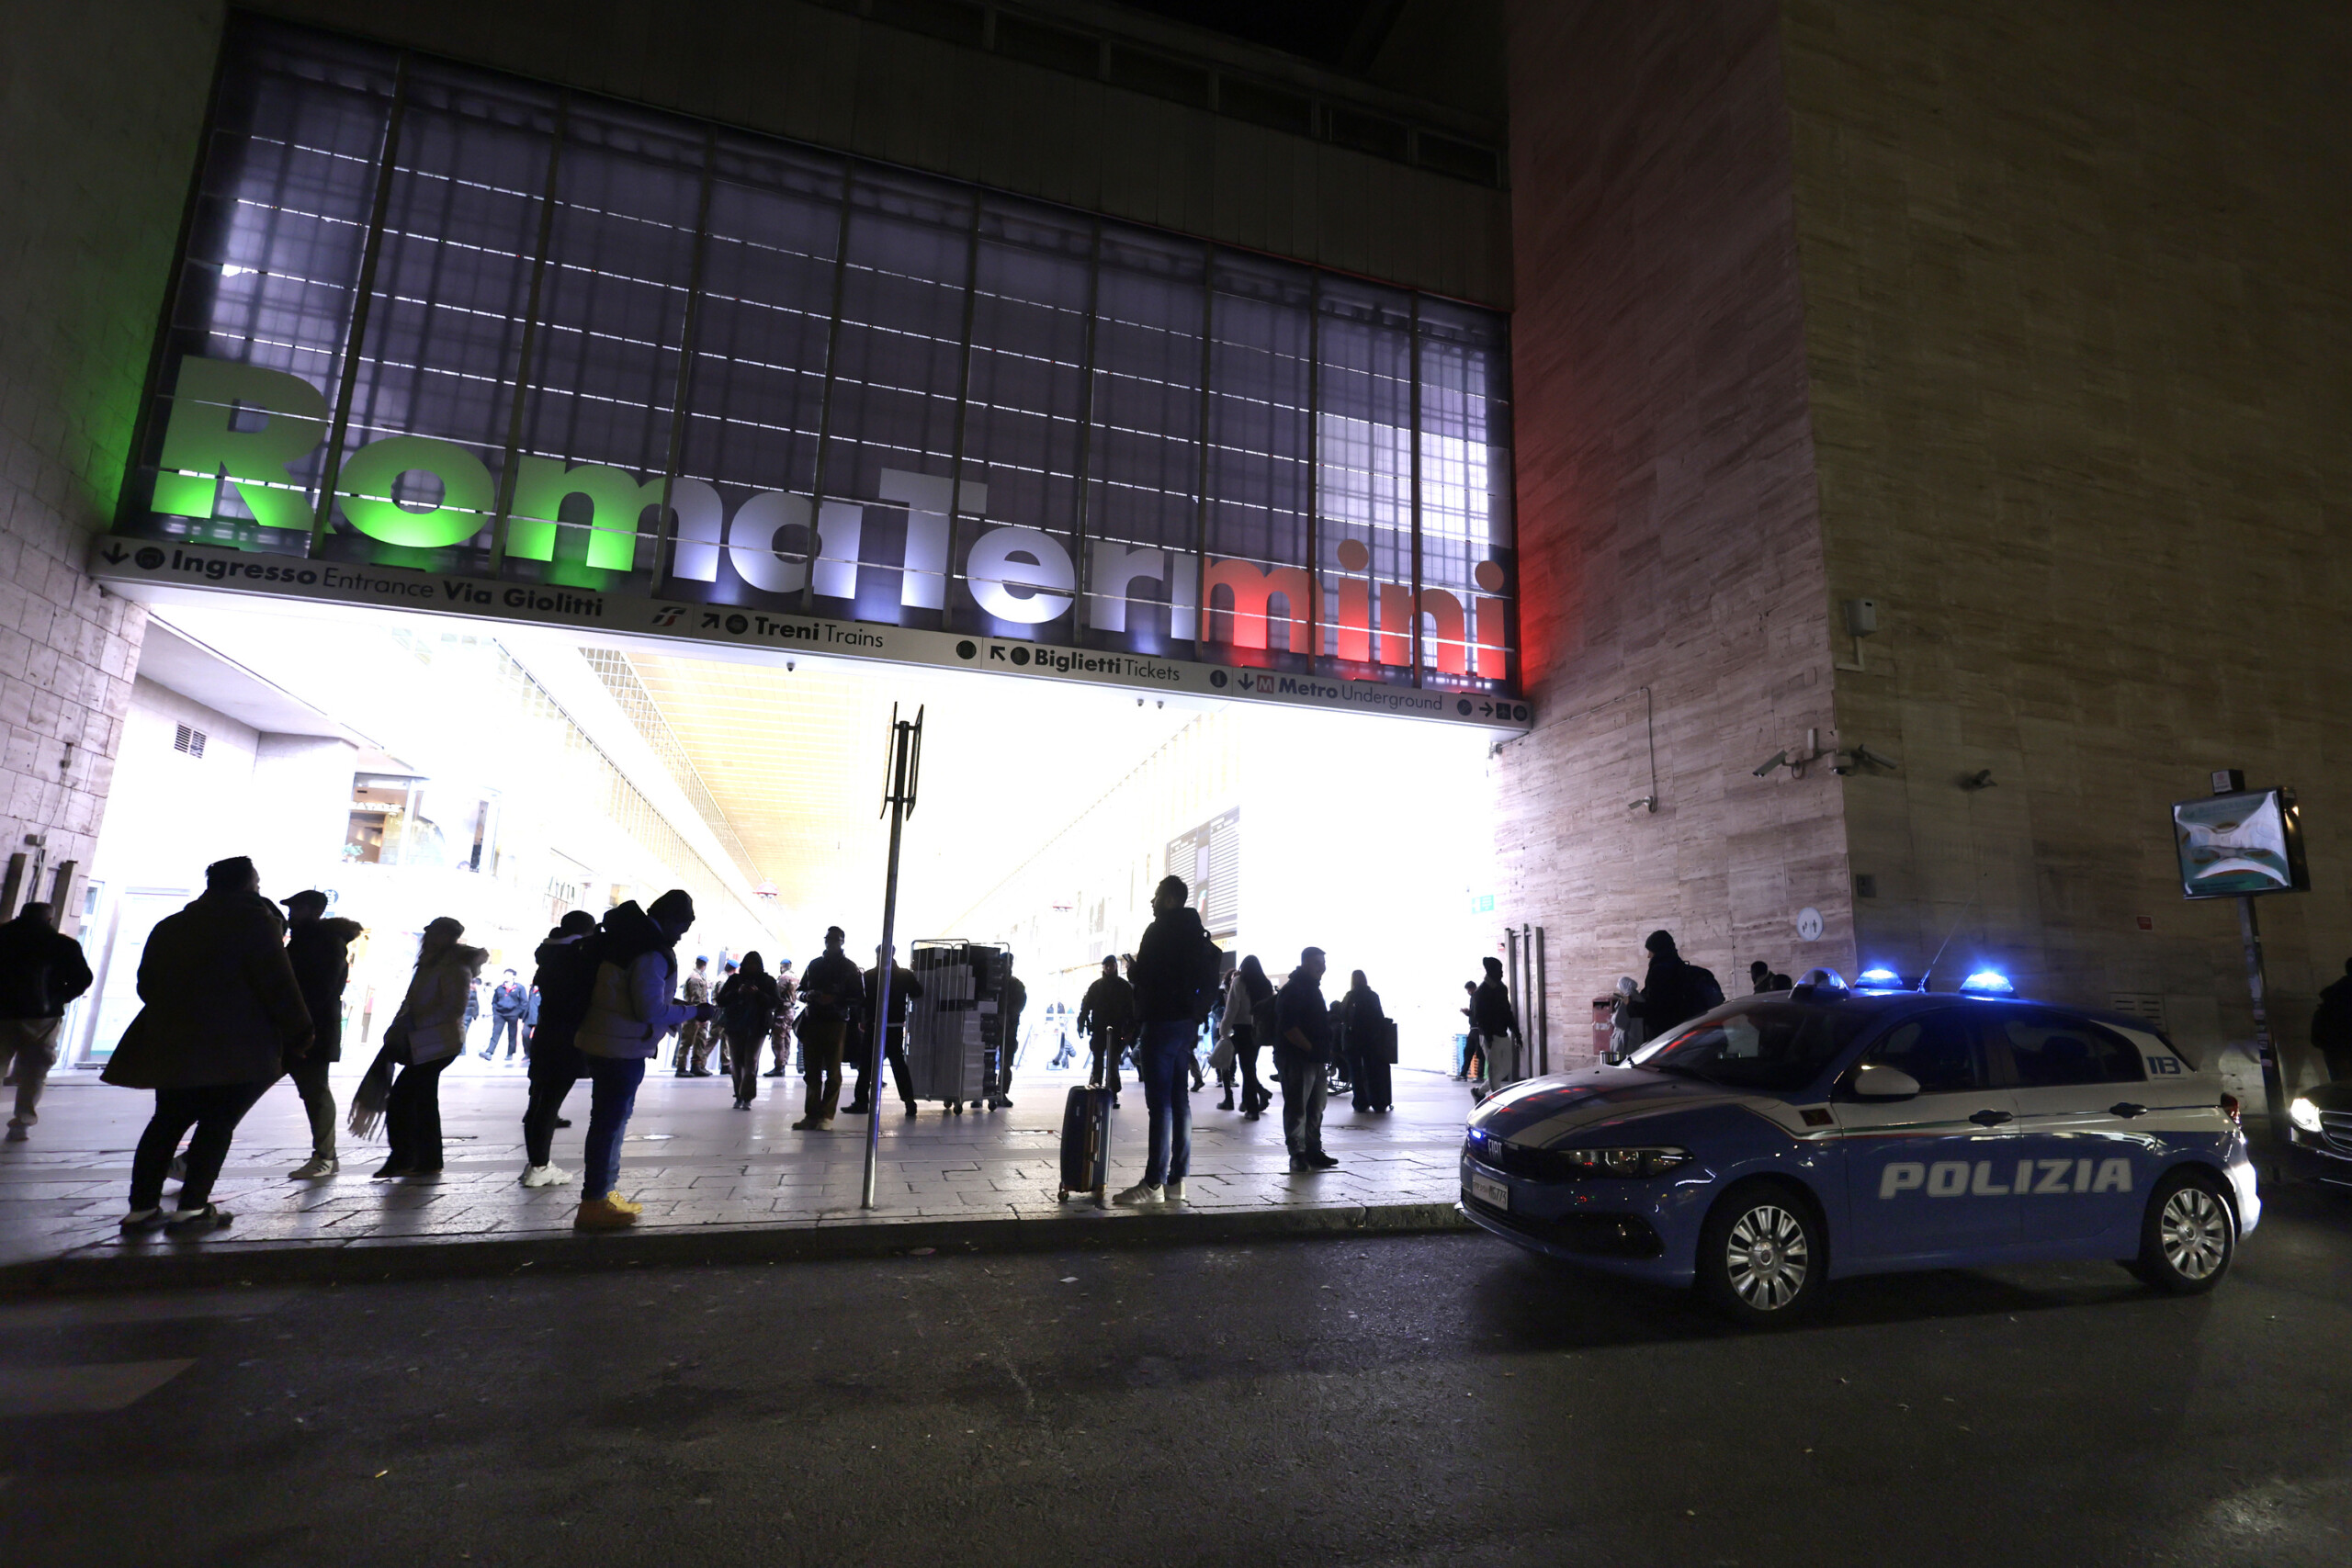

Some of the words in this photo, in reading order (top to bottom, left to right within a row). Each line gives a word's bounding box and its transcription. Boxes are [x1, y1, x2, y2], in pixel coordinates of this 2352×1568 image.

[172, 550, 317, 584] Ingresso
[323, 569, 434, 598] Entrance
[443, 581, 492, 605] Via
[504, 589, 602, 616] Giolitti
[756, 617, 820, 641] Treni
[826, 625, 884, 648] Trains
[1035, 649, 1121, 674] Biglietti
[1125, 660, 1181, 681] Tickets
[1278, 677, 1339, 699] Metro
[1342, 685, 1442, 710] Underground
[1488, 1139, 1502, 1162] FIAT
[1880, 1158, 2132, 1199] POLIZIA
